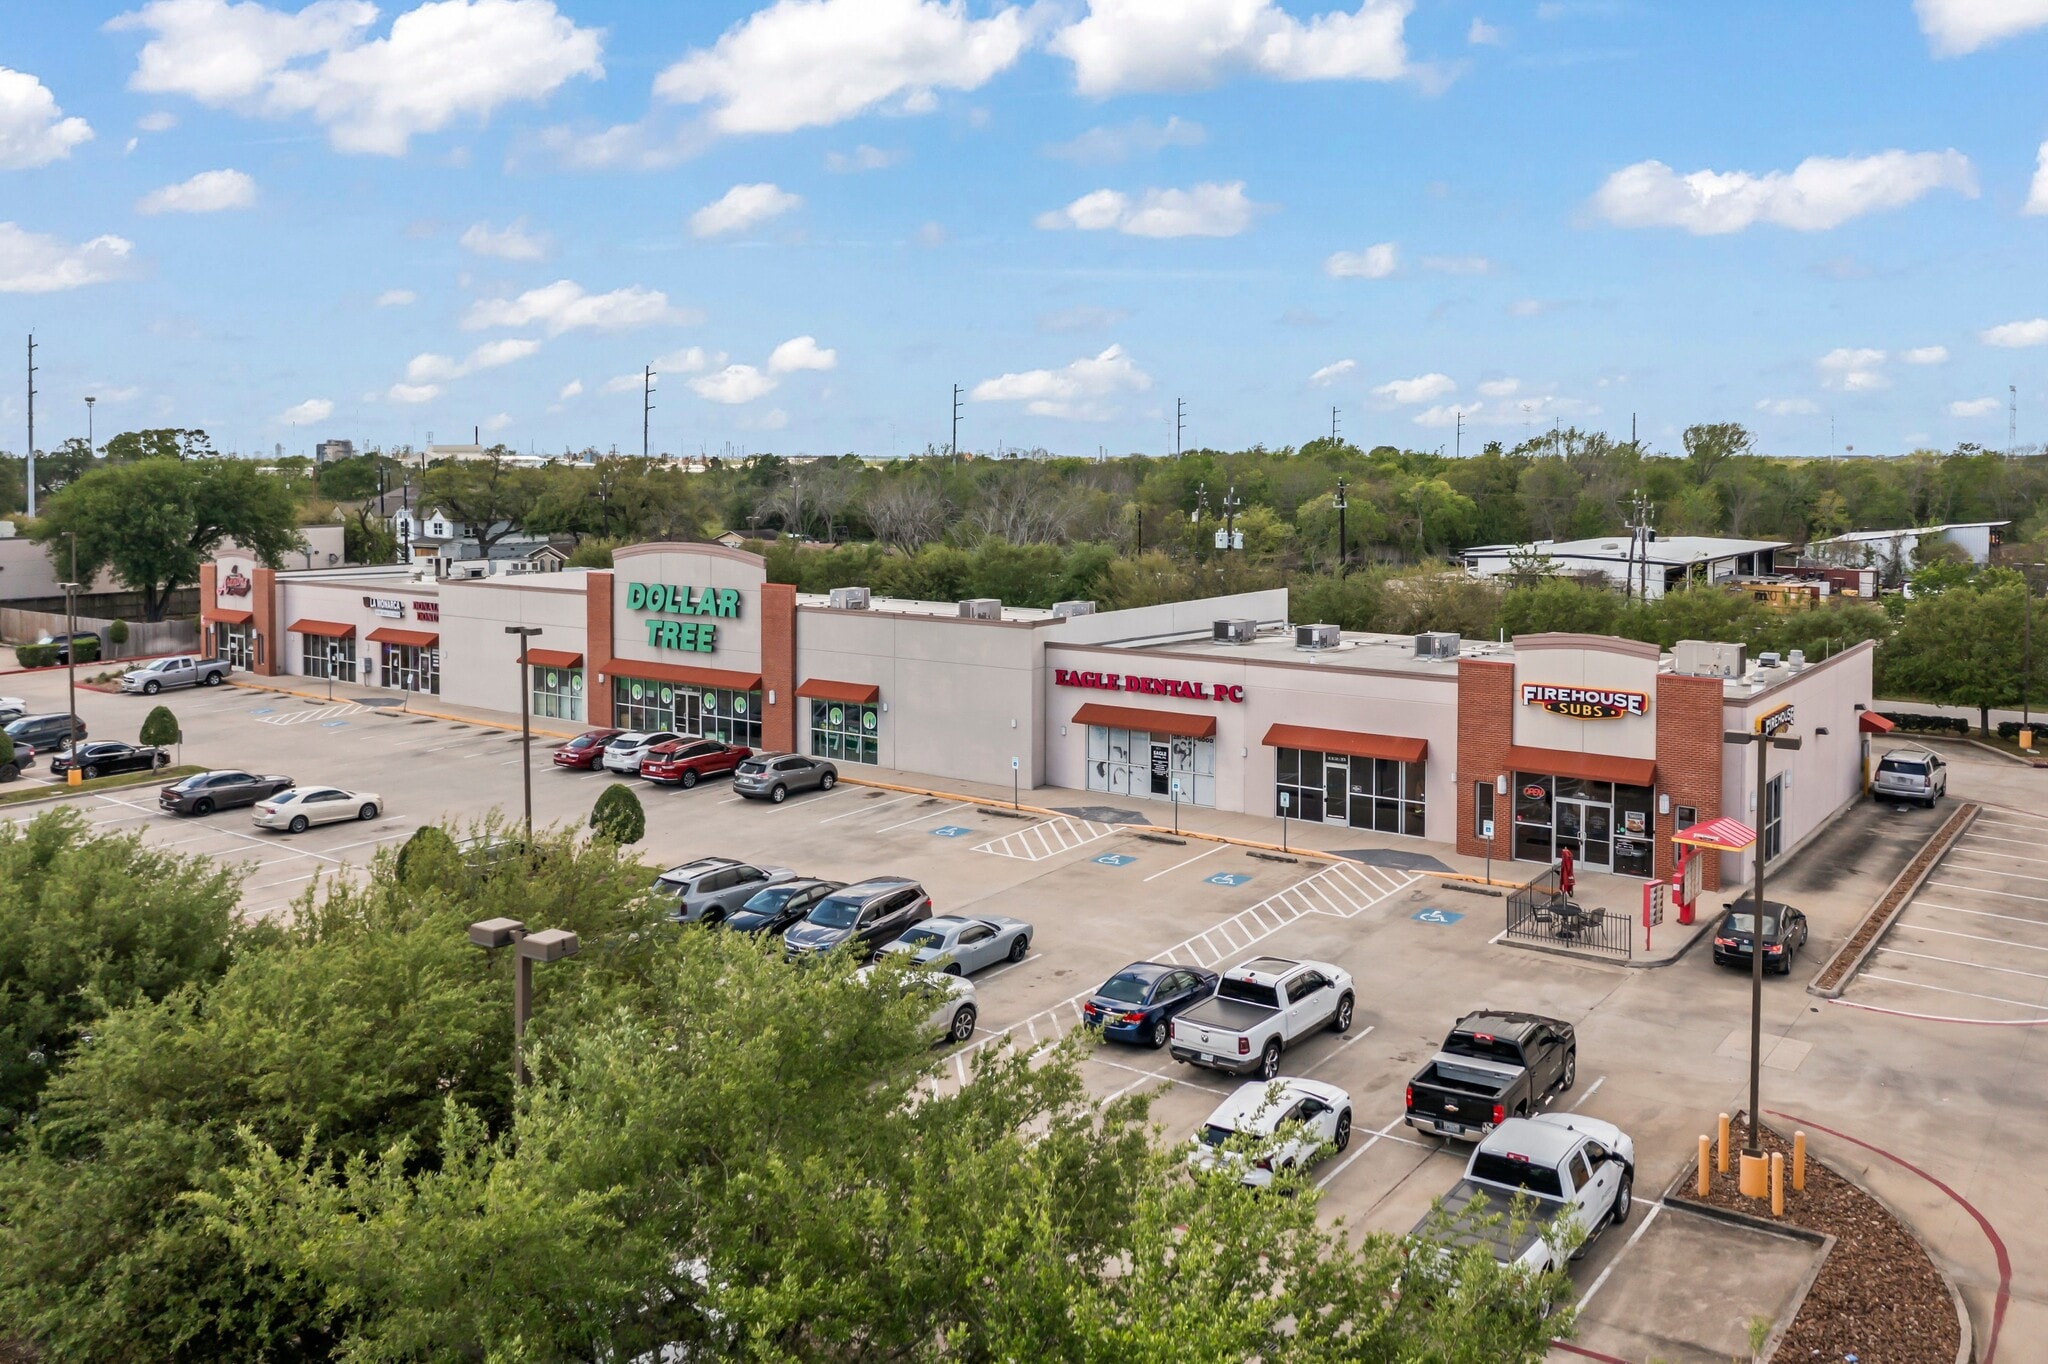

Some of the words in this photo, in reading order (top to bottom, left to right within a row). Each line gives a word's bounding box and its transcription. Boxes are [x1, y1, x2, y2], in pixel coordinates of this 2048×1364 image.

[626, 582, 740, 618] DOLLAR
[645, 619, 715, 652] TREE
[1055, 669, 1120, 691] EAGLE
[1125, 675, 1207, 700] DENTAL
[1213, 684, 1243, 703] PC
[1523, 685, 1643, 716] FIREHOUSE
[1559, 702, 1603, 717] SUBS
[1765, 705, 1794, 736] FIREHOUSE
[1524, 787, 1544, 798] OPEN
